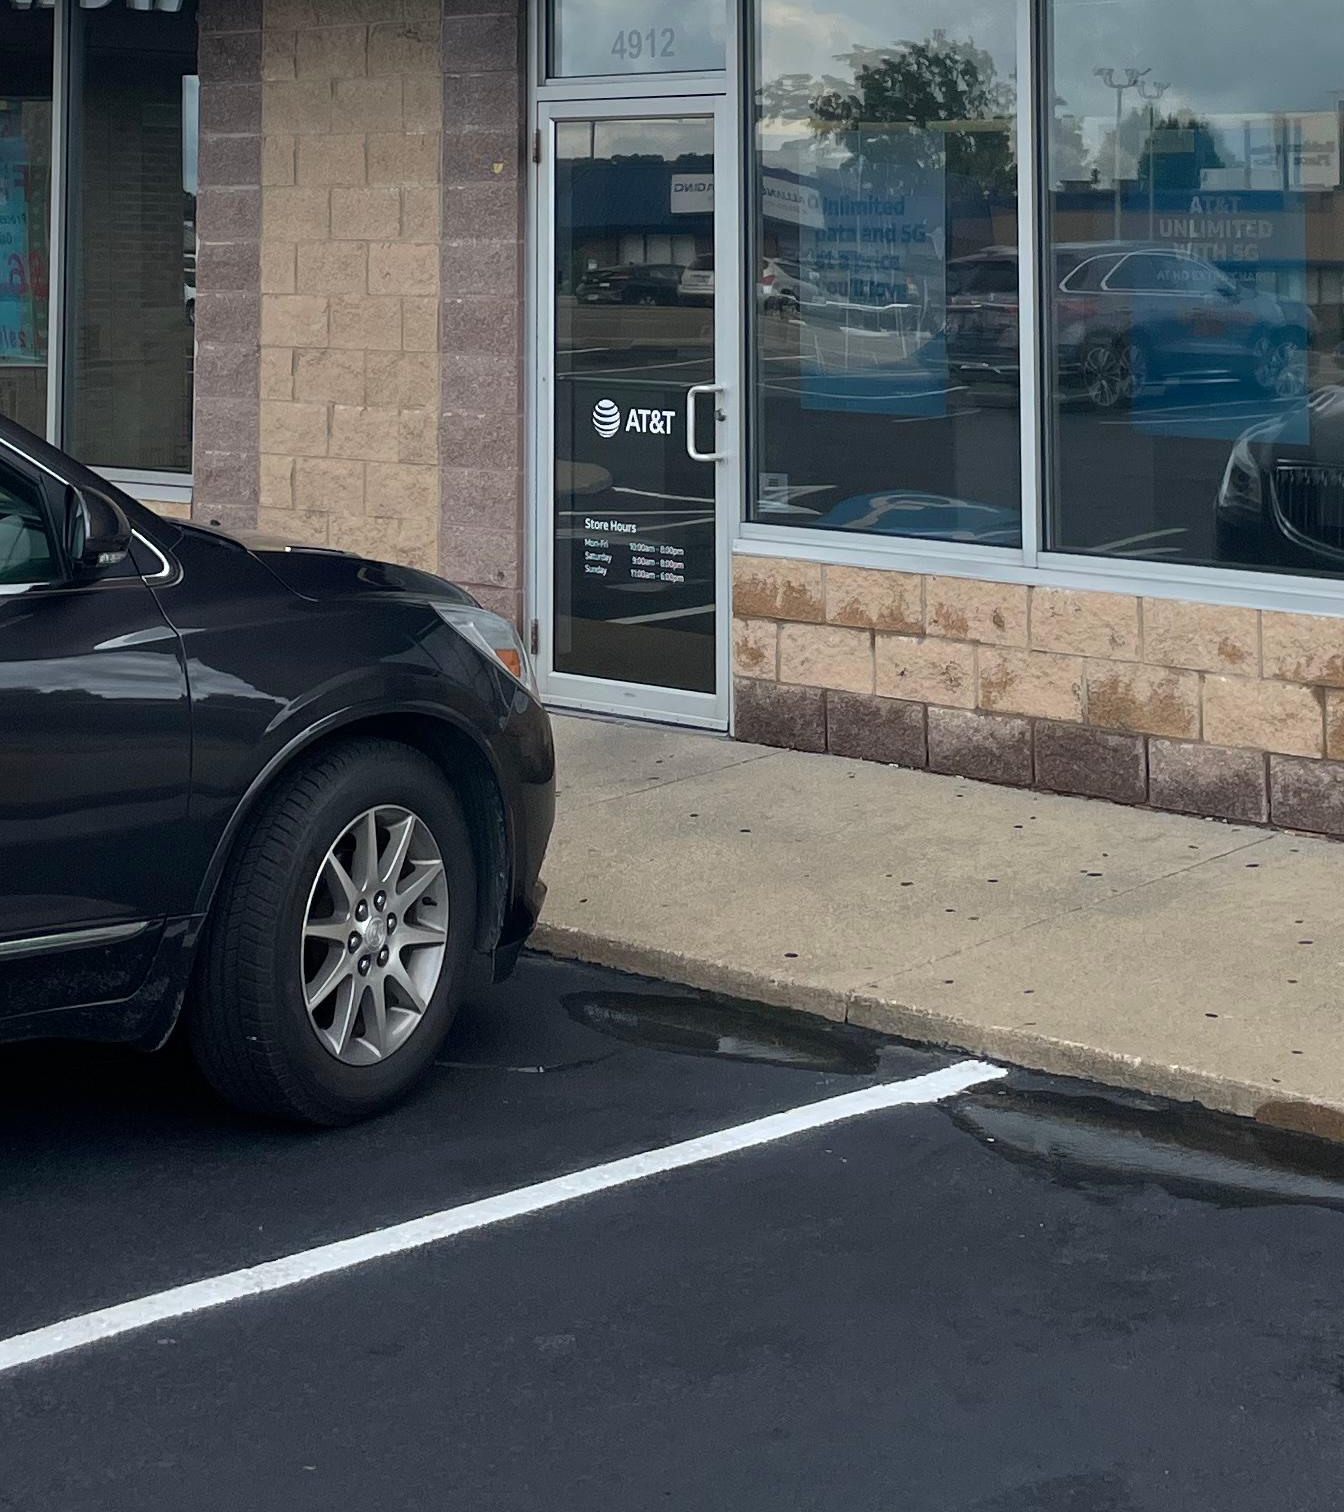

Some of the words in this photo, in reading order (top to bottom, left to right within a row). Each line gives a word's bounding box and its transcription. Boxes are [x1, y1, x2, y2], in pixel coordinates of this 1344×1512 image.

[610, 27, 676, 60] 4912
[1190, 195, 1242, 215] AT&T
[1159, 218, 1273, 239] UNLIMITED
[625, 407, 676, 435] AT&T
[584, 517, 609, 531] Store
[610, 519, 637, 534] Hours
[584, 551, 613, 565] Saturday
[584, 564, 608, 577] Sunday
